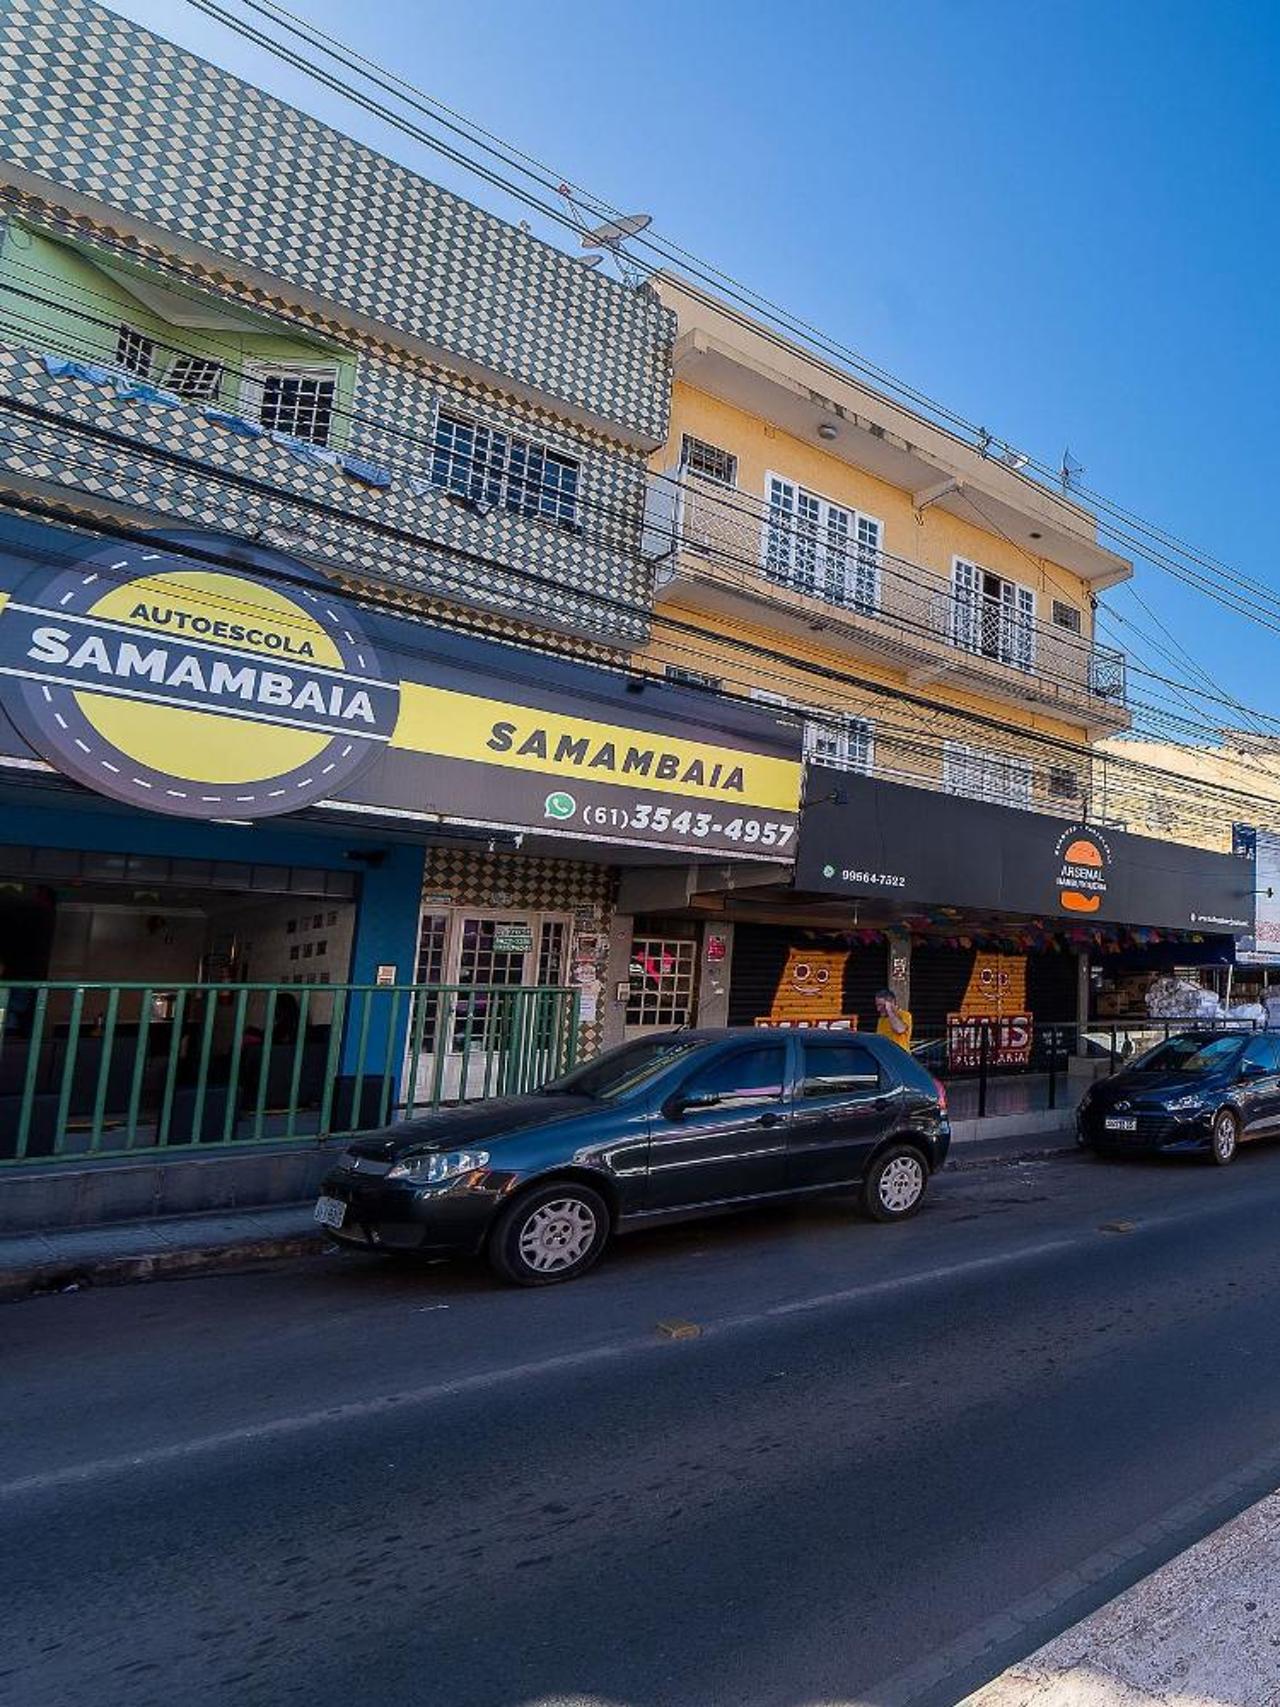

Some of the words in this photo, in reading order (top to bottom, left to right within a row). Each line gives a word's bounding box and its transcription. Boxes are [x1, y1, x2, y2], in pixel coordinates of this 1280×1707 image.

[129, 603, 315, 658] AUTOESCOLA
[27, 626, 376, 724] SAMAMBAIA
[486, 721, 745, 793] SAMAMBAIA
[1060, 865, 1105, 882] ARSENAL
